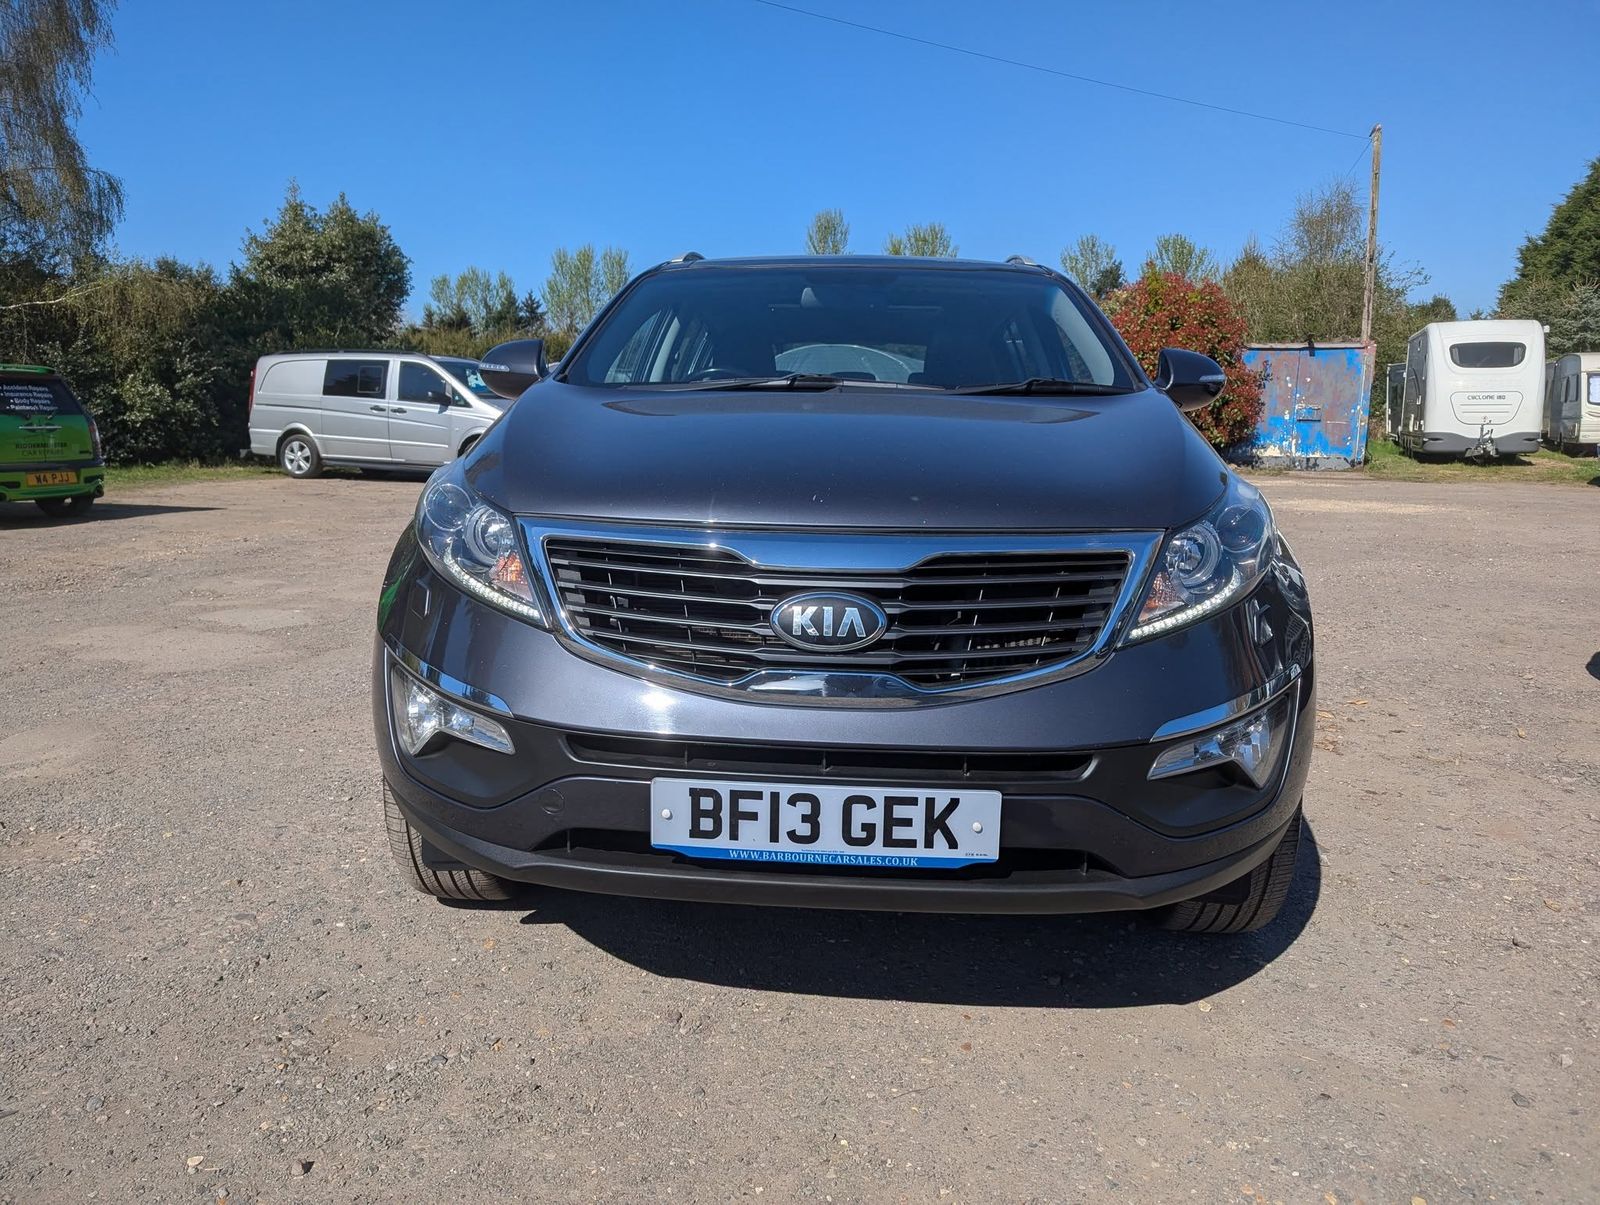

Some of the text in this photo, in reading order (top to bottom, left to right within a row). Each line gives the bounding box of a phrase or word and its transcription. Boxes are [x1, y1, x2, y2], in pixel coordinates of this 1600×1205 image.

[52, 473, 70, 483] PJJ
[792, 606, 866, 637] KIA
[689, 788, 960, 850] BF13 GEK
[729, 850, 918, 867] WWW.BARBOURNECARSALES.CO.UK
